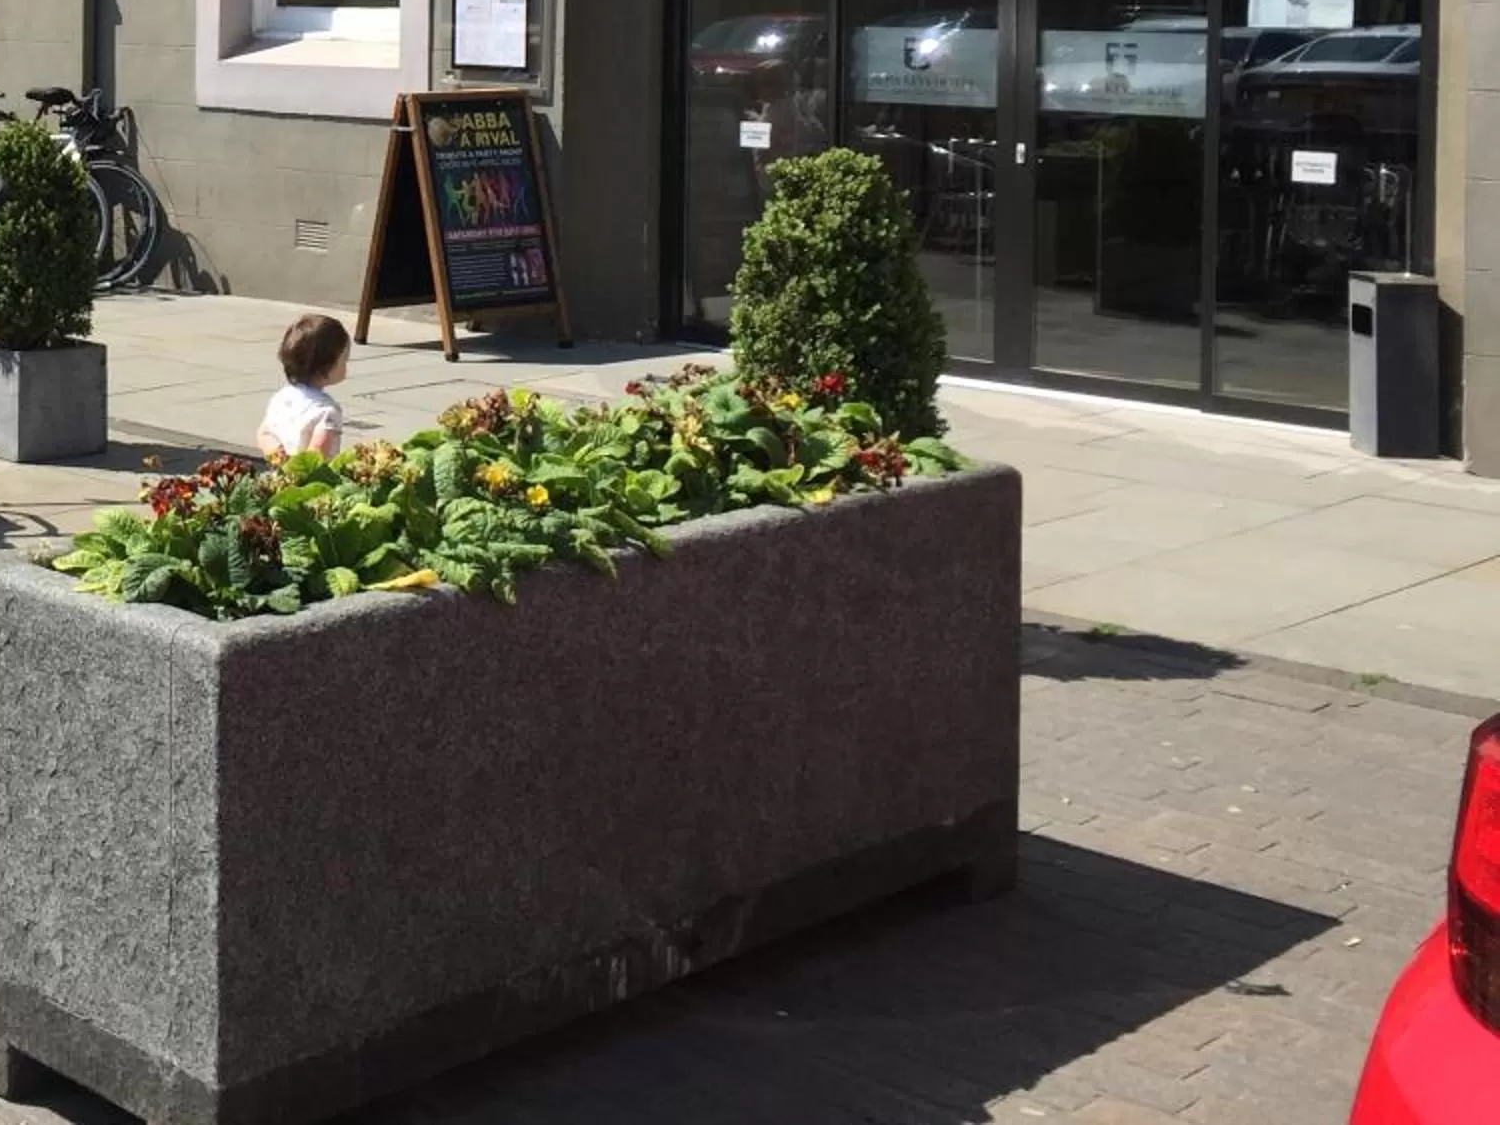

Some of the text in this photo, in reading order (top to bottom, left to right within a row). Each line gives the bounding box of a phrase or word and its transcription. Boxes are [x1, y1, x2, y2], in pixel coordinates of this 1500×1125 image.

[462, 112, 511, 130] ABBA
[461, 130, 520, 147] A RIVAL
